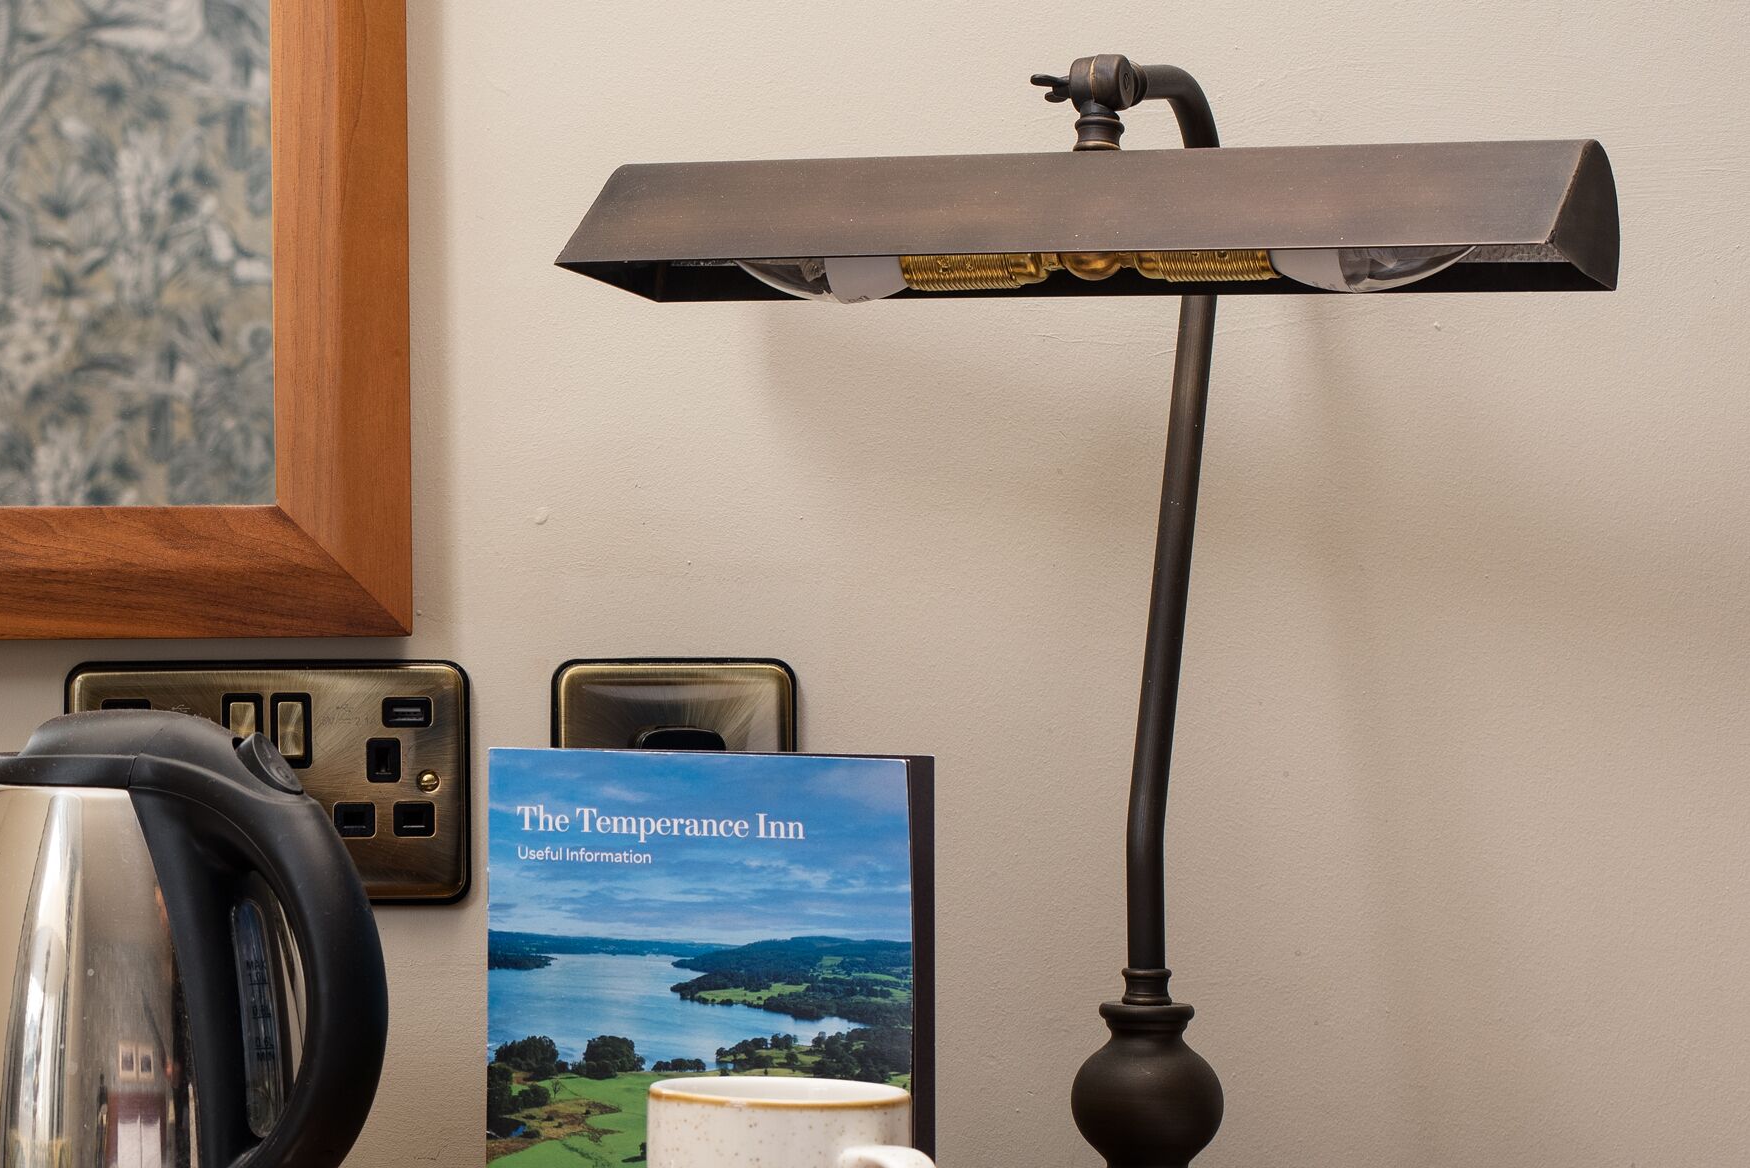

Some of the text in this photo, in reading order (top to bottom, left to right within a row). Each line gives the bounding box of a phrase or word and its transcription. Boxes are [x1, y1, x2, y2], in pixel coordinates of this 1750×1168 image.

[516, 804, 806, 843] The Temperance Inn
[517, 845, 652, 864] Useful Information
